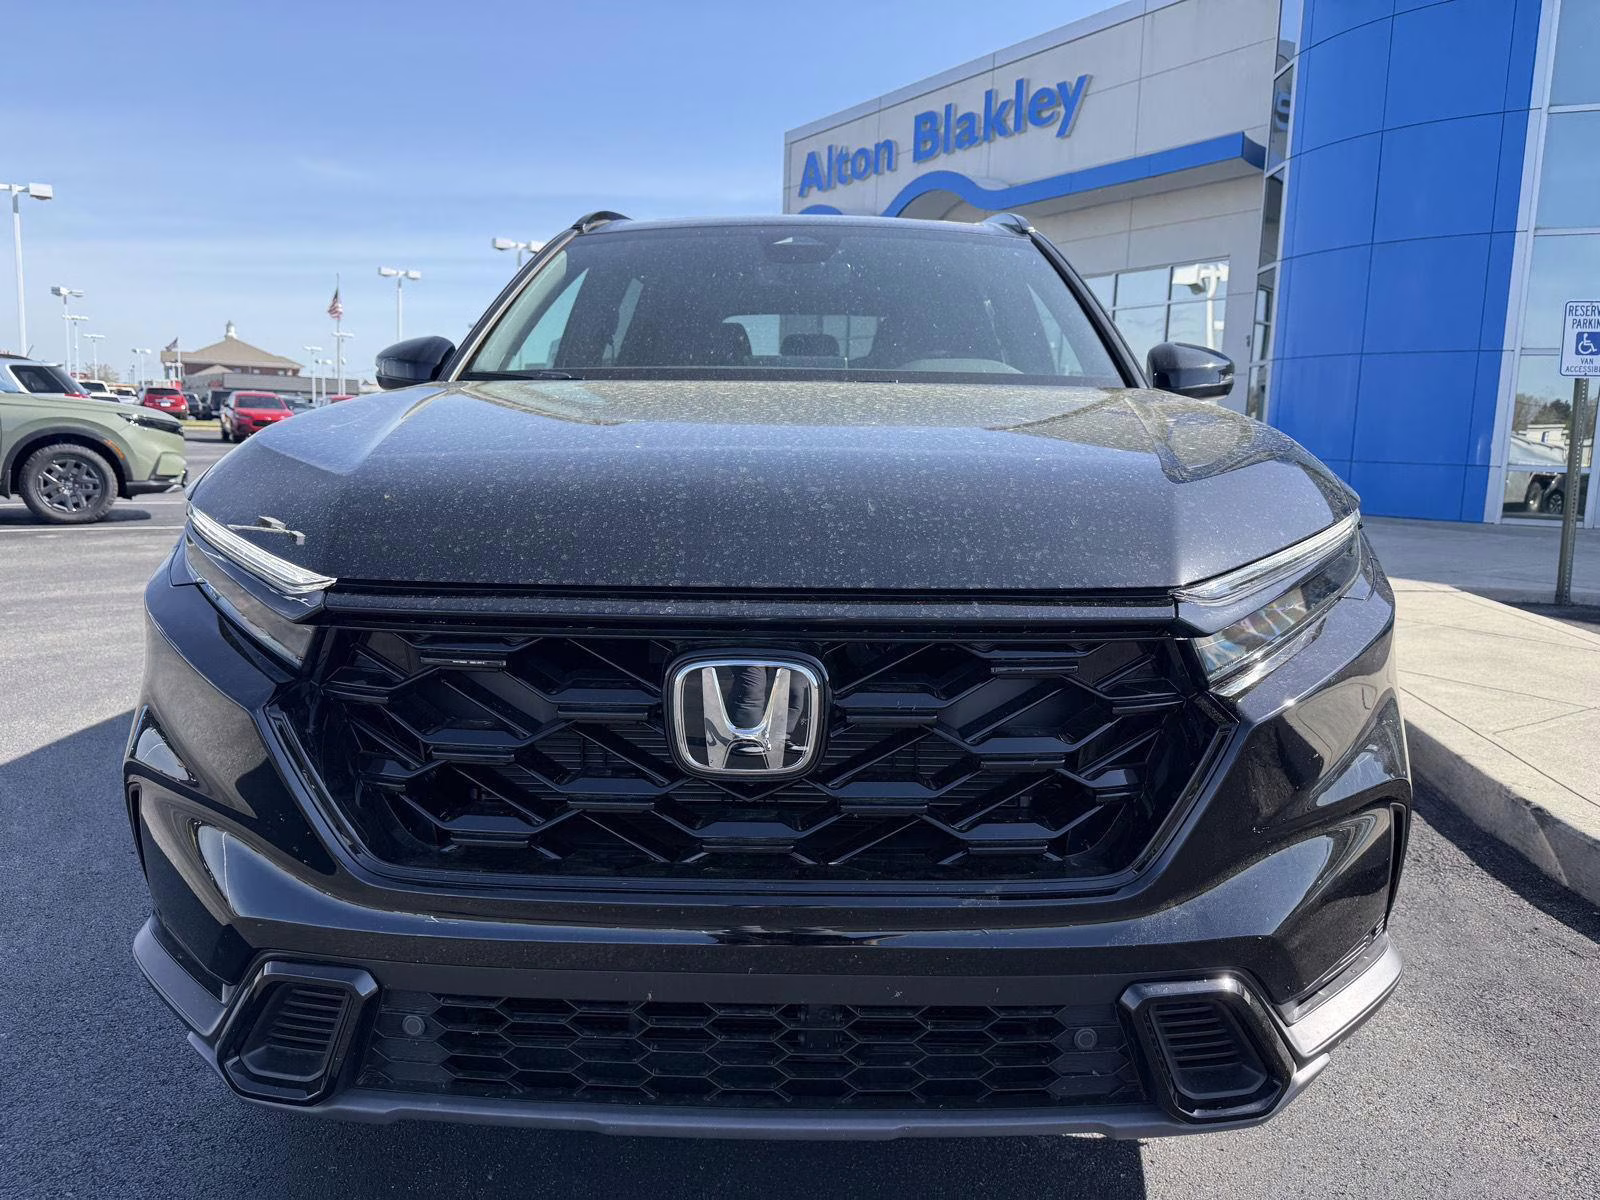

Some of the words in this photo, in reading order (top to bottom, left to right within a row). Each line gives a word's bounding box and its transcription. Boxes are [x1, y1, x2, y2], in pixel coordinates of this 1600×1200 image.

[798, 138, 898, 198] Alton
[912, 74, 1094, 163] Blakley
[1580, 357, 1594, 365] VAN
